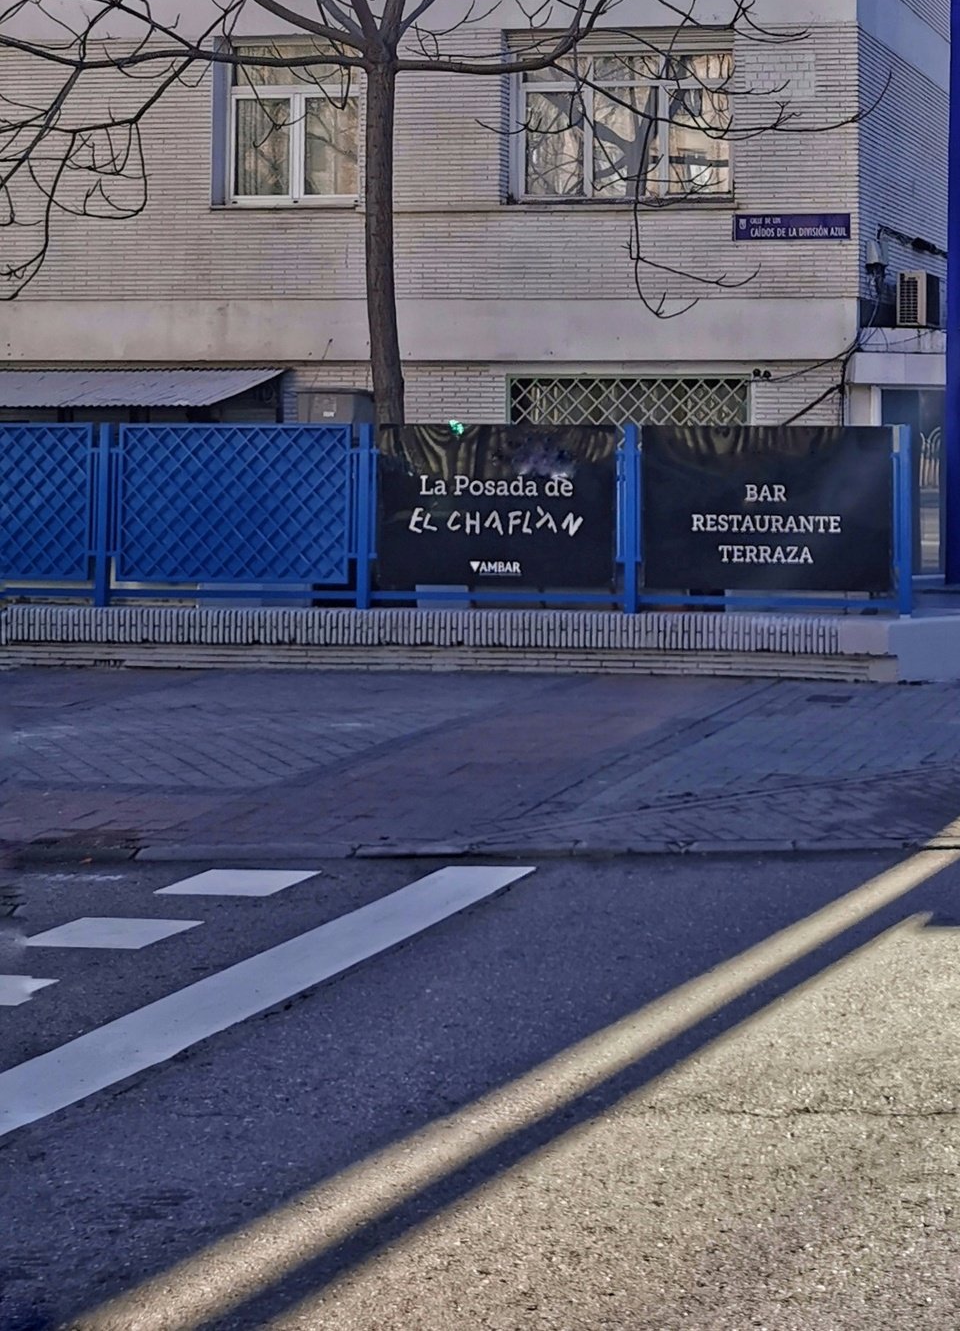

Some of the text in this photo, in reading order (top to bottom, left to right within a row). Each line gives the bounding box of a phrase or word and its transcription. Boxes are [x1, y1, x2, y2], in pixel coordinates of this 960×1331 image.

[750, 225, 847, 237] CAÍDOS DE LA DIVISIÓN AZUL
[419, 475, 574, 497] La Posada de
[744, 484, 787, 502] BAR
[408, 507, 438, 534] EL
[691, 513, 841, 533] RESTAURANTE
[718, 544, 814, 564] TERRAZA
[479, 561, 522, 573] AMBAR
